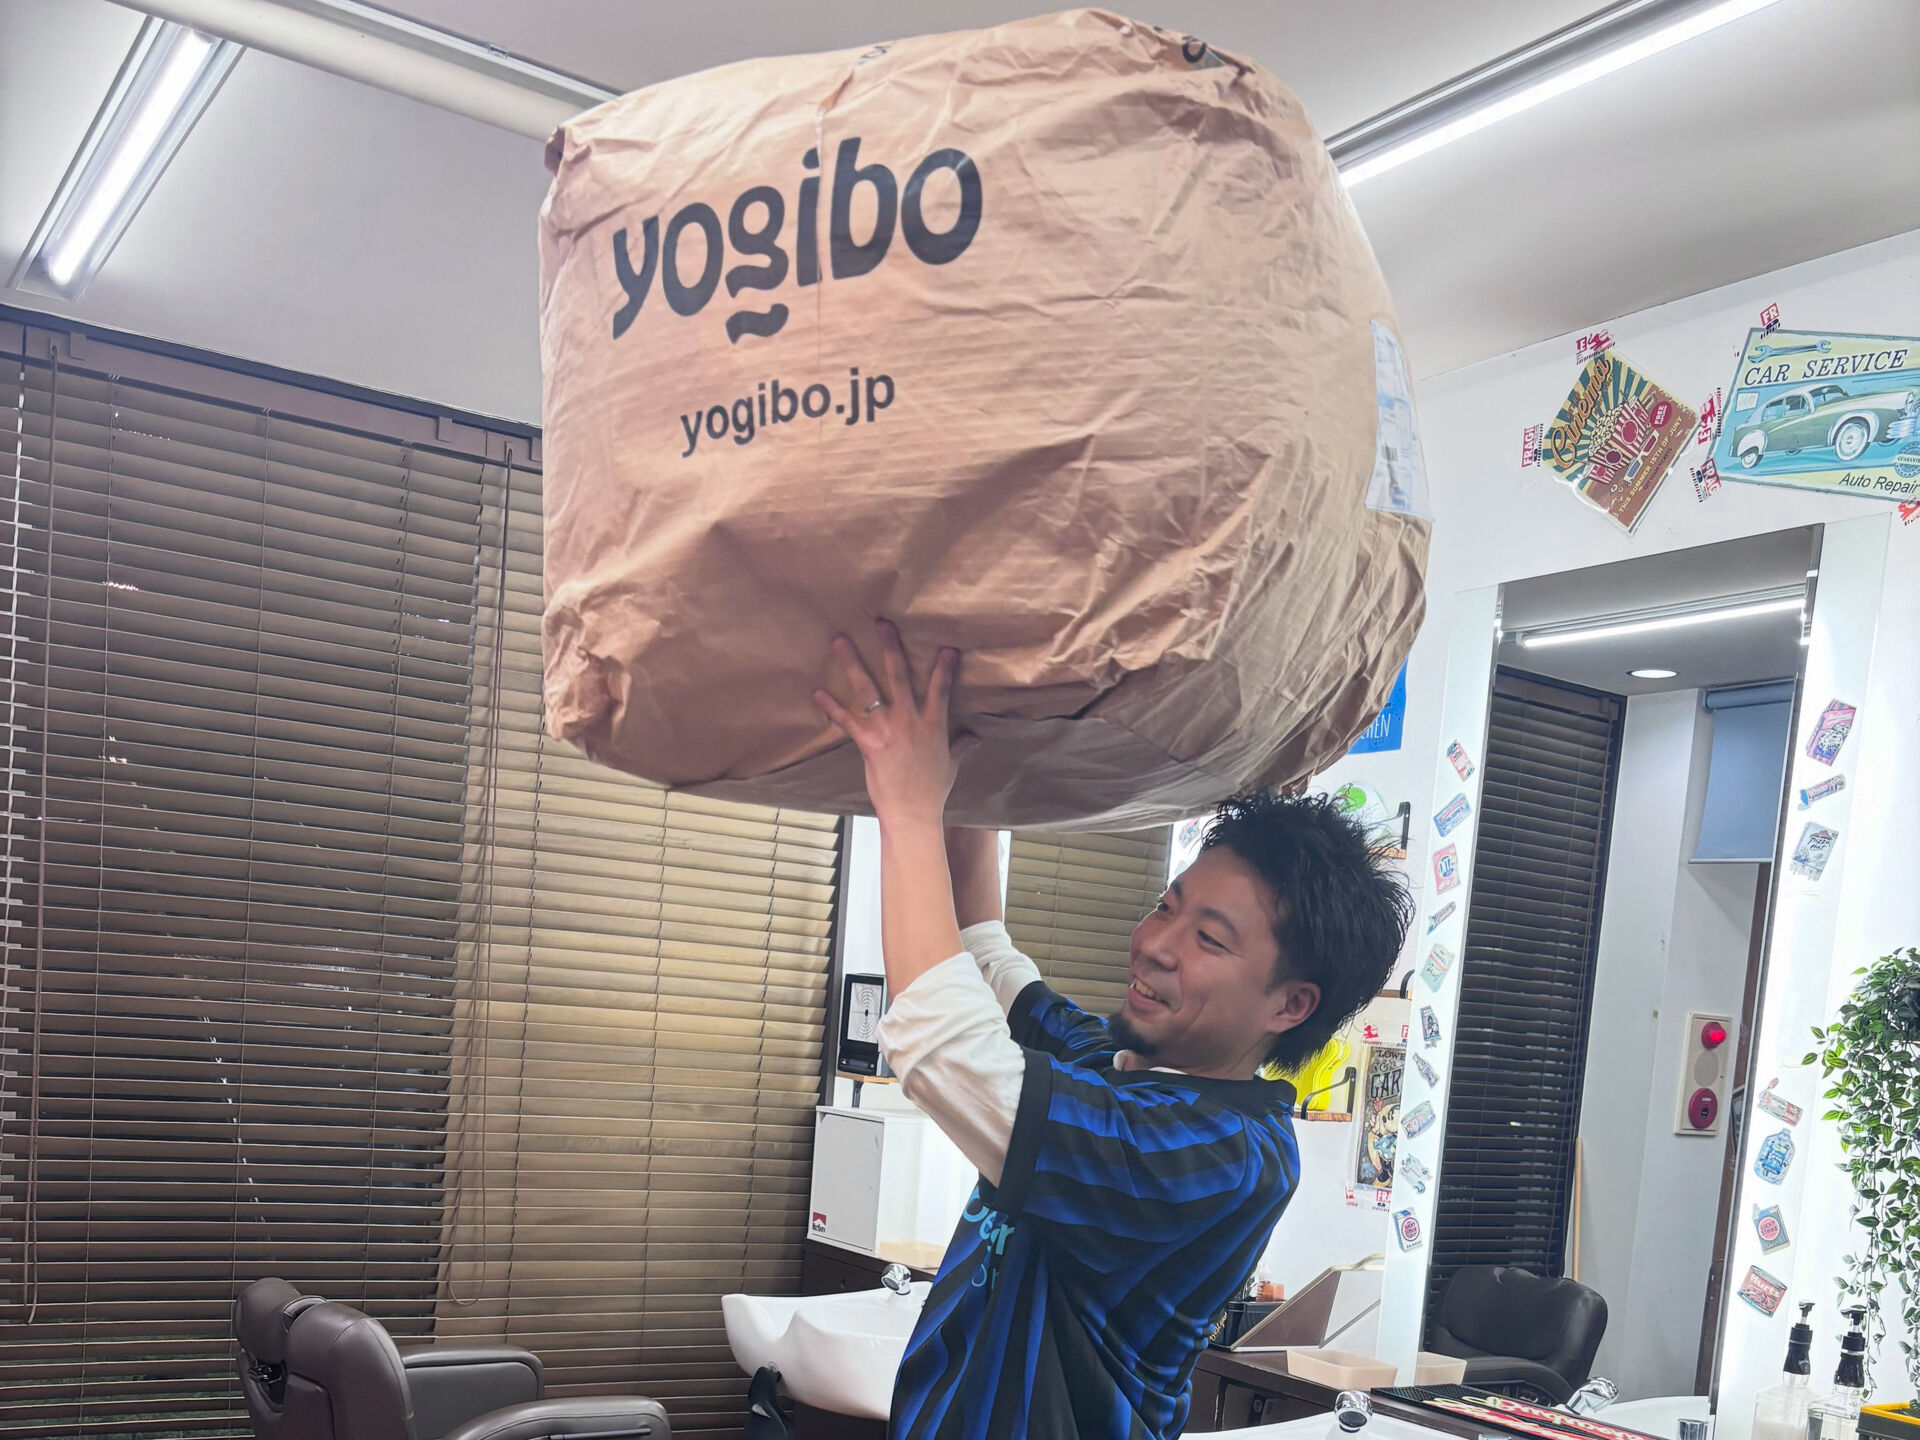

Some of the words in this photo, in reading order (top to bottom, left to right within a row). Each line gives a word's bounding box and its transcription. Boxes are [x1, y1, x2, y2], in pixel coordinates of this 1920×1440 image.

[612, 136, 983, 344] yogibo
[1745, 364, 1791, 386] CAR
[1802, 349, 1908, 379] SERVICE
[680, 367, 895, 457] yogibo.jp
[1551, 358, 1612, 469] Cinema
[1619, 497, 1631, 512] THIS
[1630, 466, 1651, 496] SUMMER
[1839, 472, 1871, 488] Auto
[1873, 476, 1920, 494] Repair
